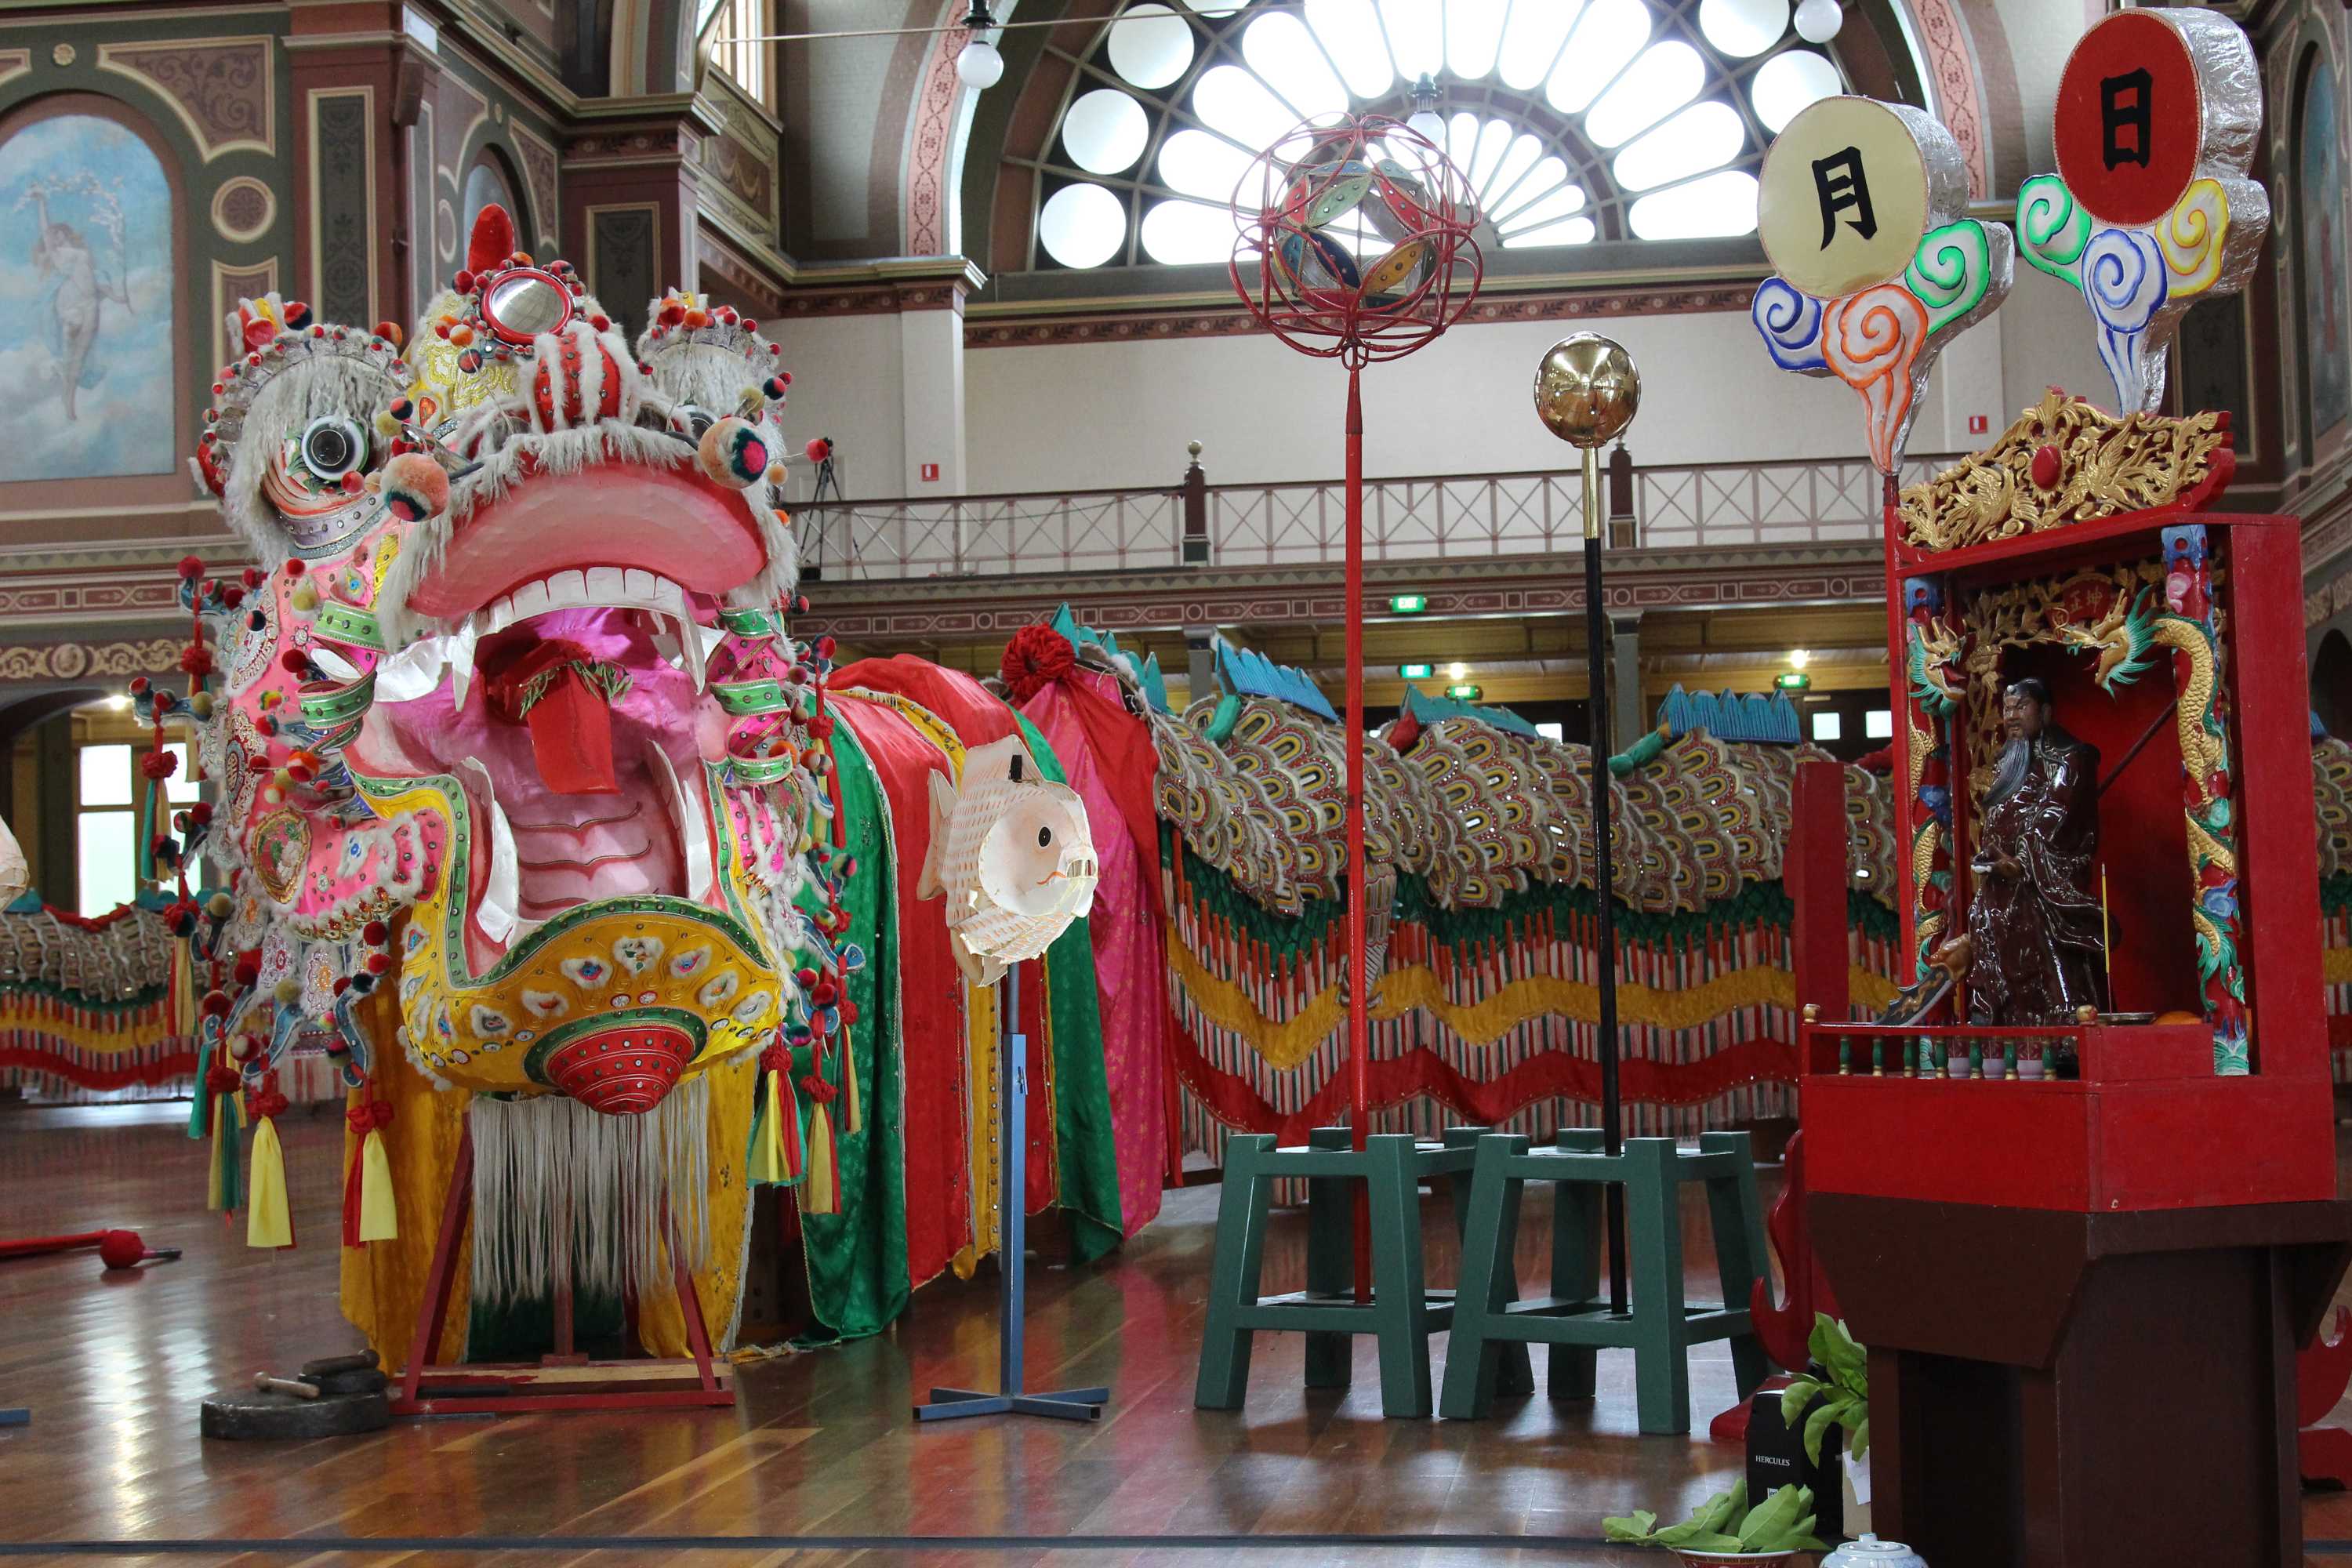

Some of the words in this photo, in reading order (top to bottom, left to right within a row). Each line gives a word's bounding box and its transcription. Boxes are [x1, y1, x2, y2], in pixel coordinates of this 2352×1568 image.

[2100, 67, 2153, 172] 日
[1812, 146, 1878, 251] 月
[1399, 597, 1417, 608] EXIT
[1755, 1455, 1790, 1466] HERCULES
